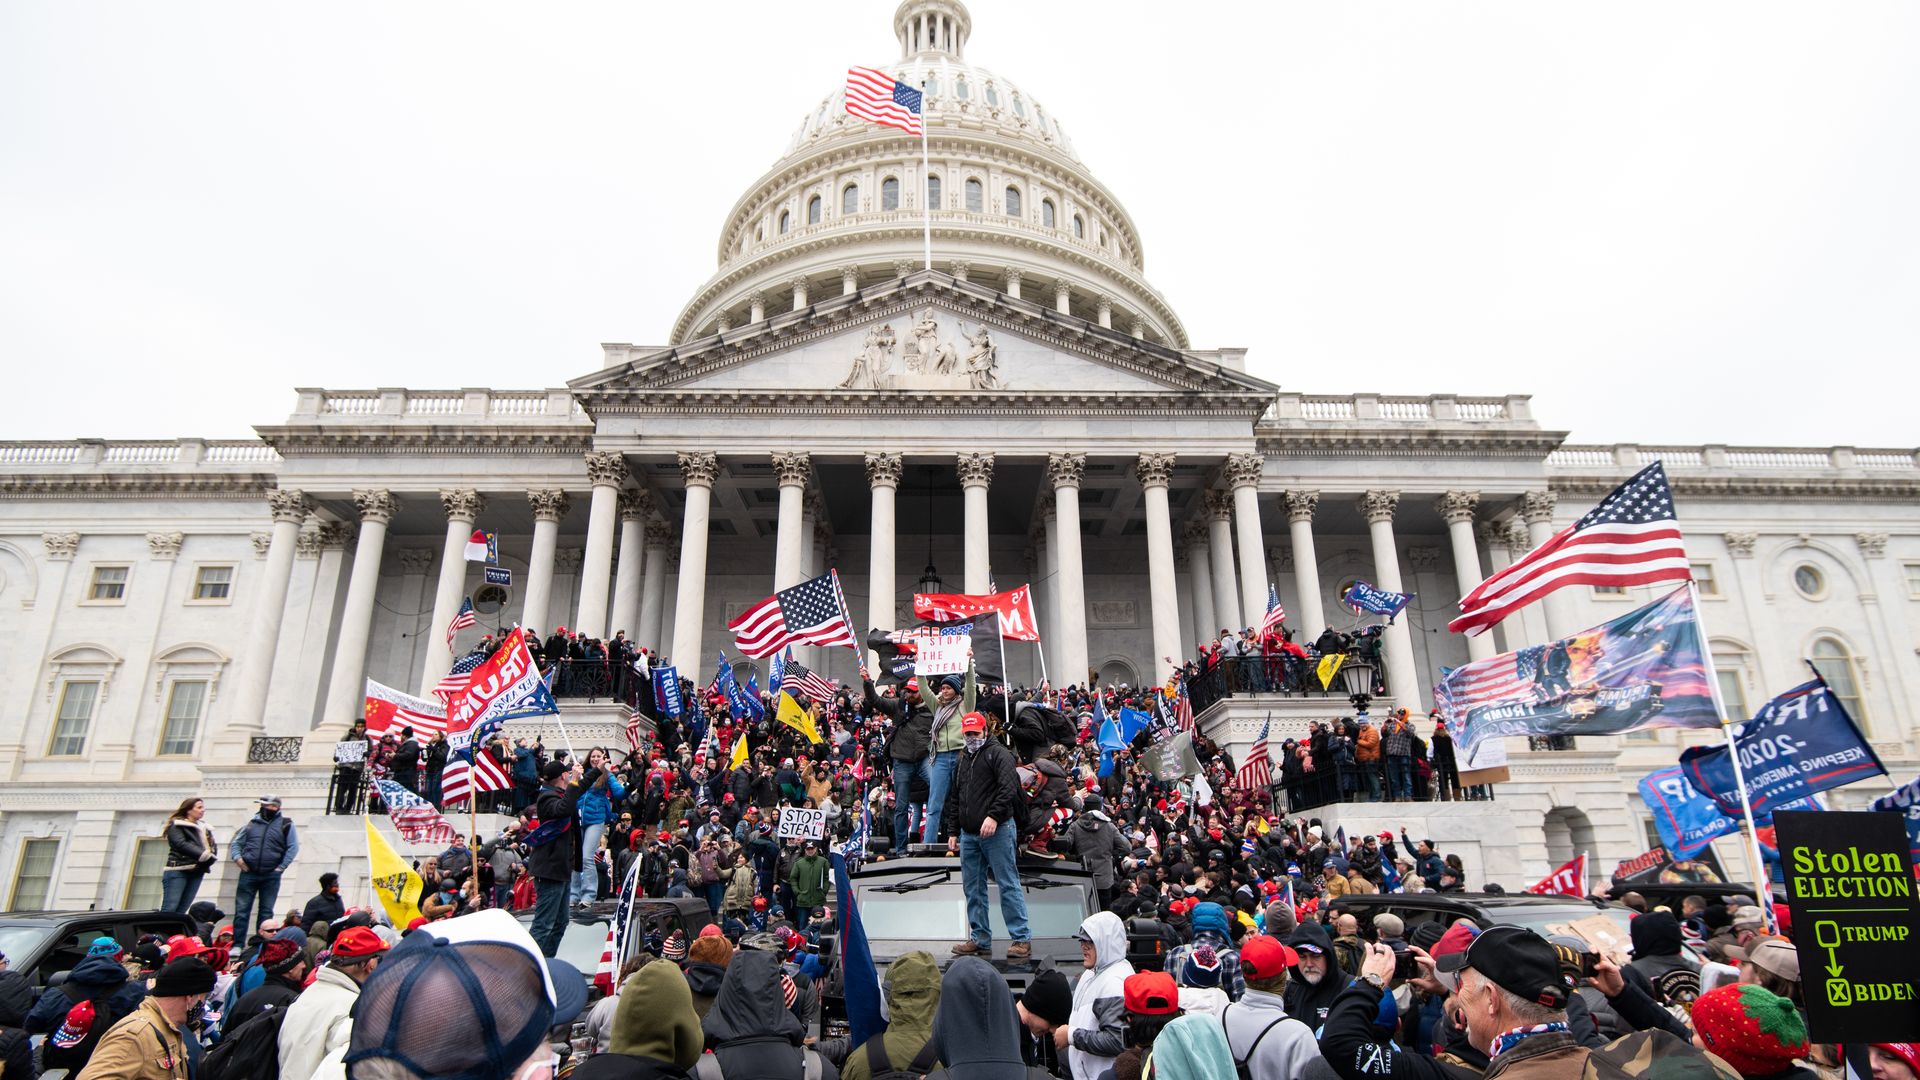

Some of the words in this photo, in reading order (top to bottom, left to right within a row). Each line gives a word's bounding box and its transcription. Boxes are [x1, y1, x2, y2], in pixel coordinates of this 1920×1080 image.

[929, 636, 962, 647] STOP
[922, 651, 943, 661] THE
[927, 662, 963, 673] STEAL
[662, 670, 681, 714] TRUMP
[785, 809, 823, 825] STOP
[781, 822, 823, 838] STEAL!
[1793, 846, 1903, 874] Stolen
[1794, 876, 1910, 898] ELECTION
[1842, 926, 1909, 942] TRUMP
